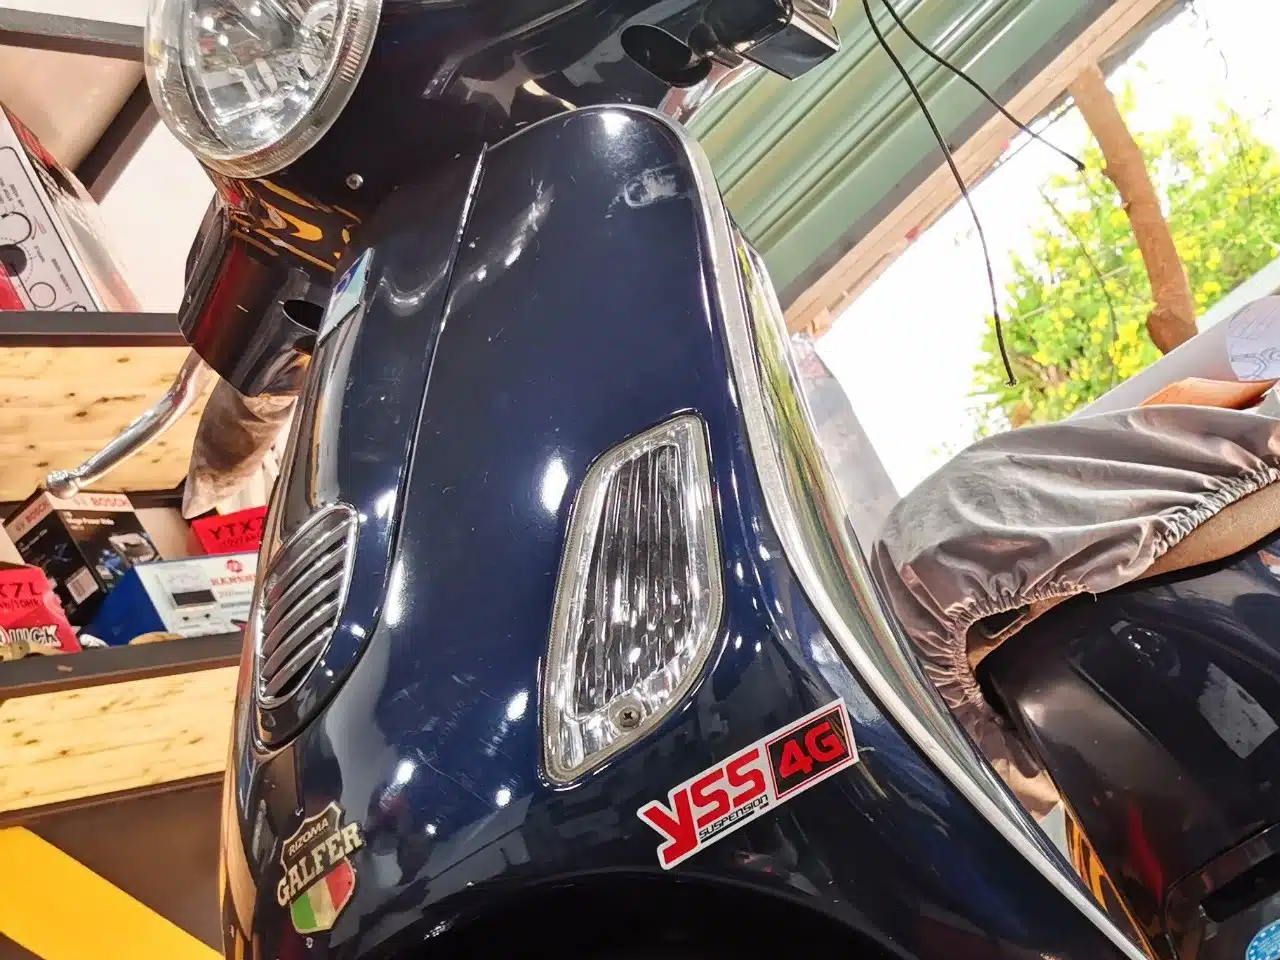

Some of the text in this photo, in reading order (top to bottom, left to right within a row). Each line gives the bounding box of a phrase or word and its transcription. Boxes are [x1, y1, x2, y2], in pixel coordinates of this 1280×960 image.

[642, 720, 847, 865] YSS 4G
[698, 793, 769, 840] SUSPENSION
[277, 821, 364, 907] GALFER
[288, 817, 330, 857] RIZOMA
